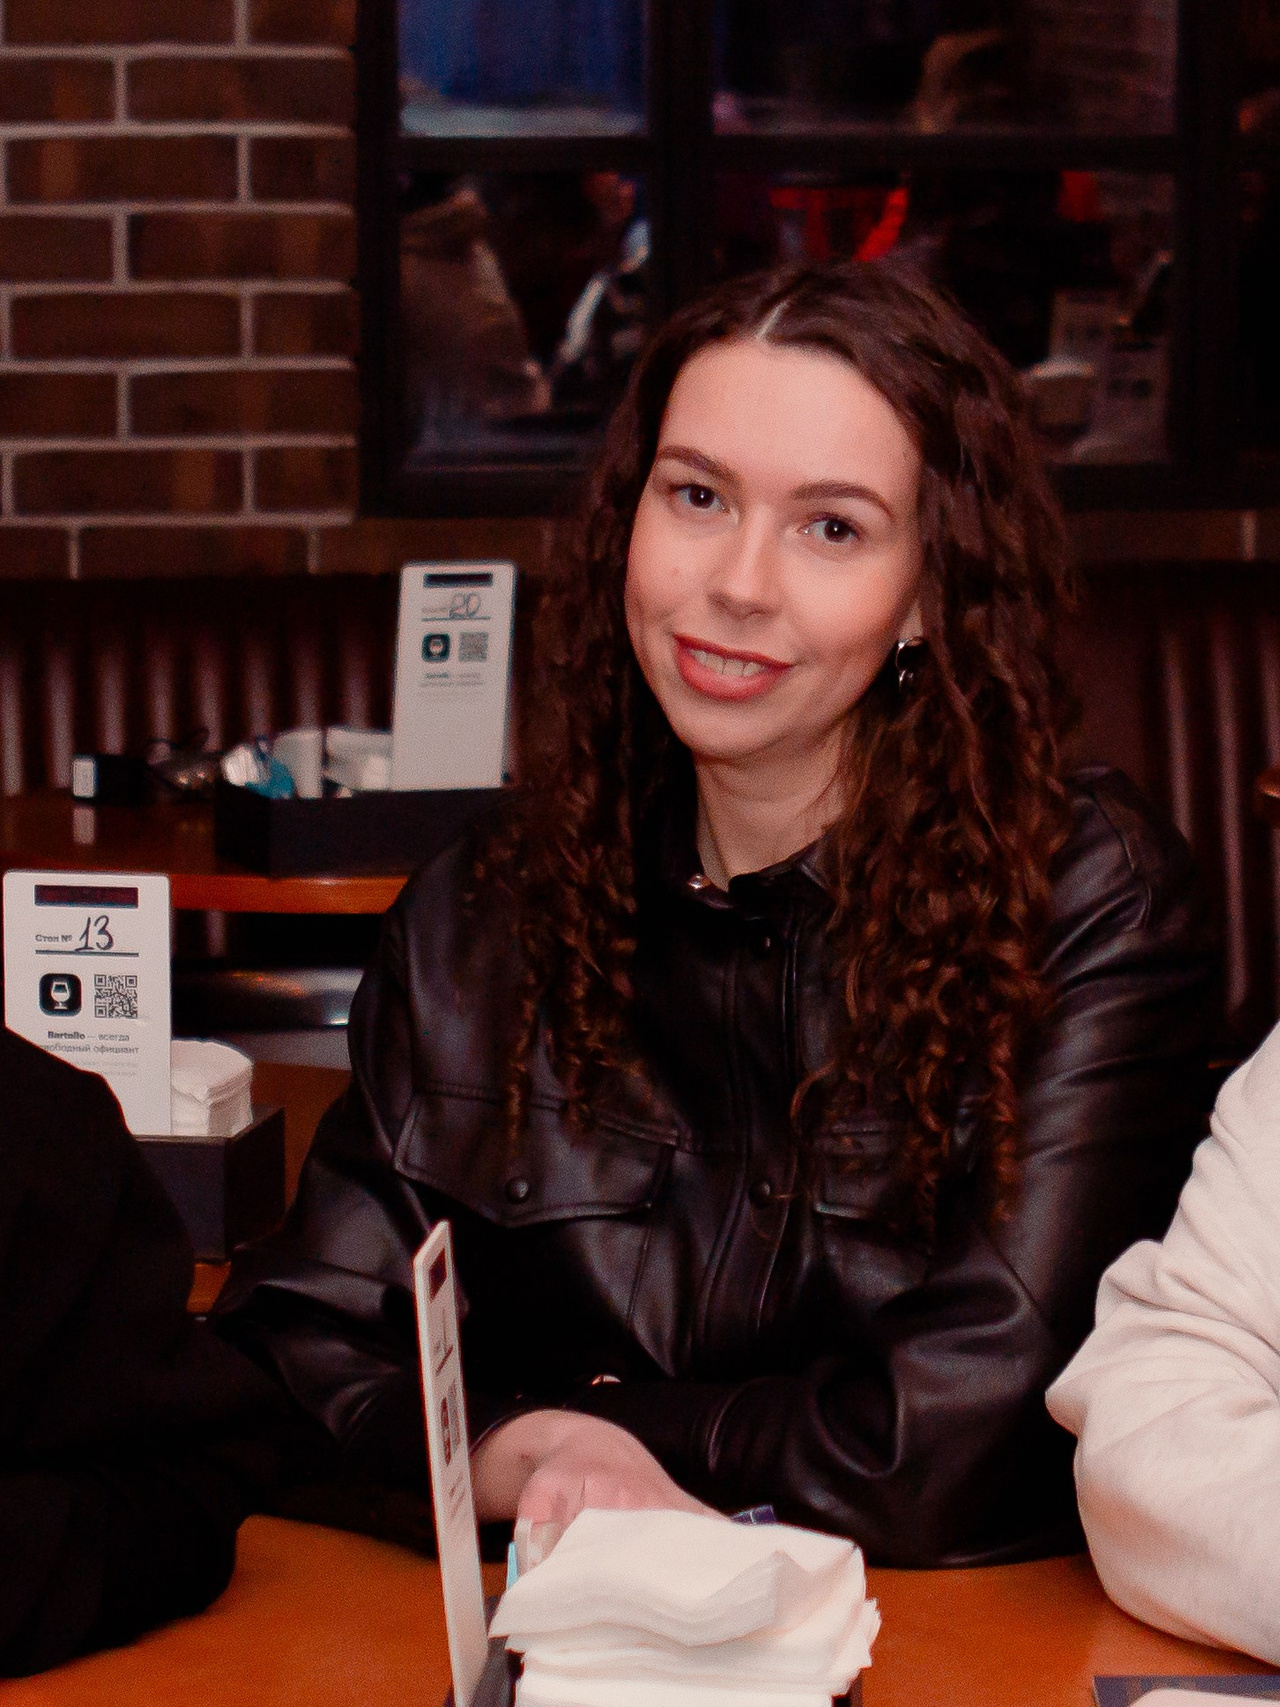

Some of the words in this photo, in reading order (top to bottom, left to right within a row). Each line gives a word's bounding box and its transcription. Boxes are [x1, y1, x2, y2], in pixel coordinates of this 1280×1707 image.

[450, 592, 481, 619] 20
[74, 914, 115, 952] 13
[94, 1044, 139, 1055] официант
